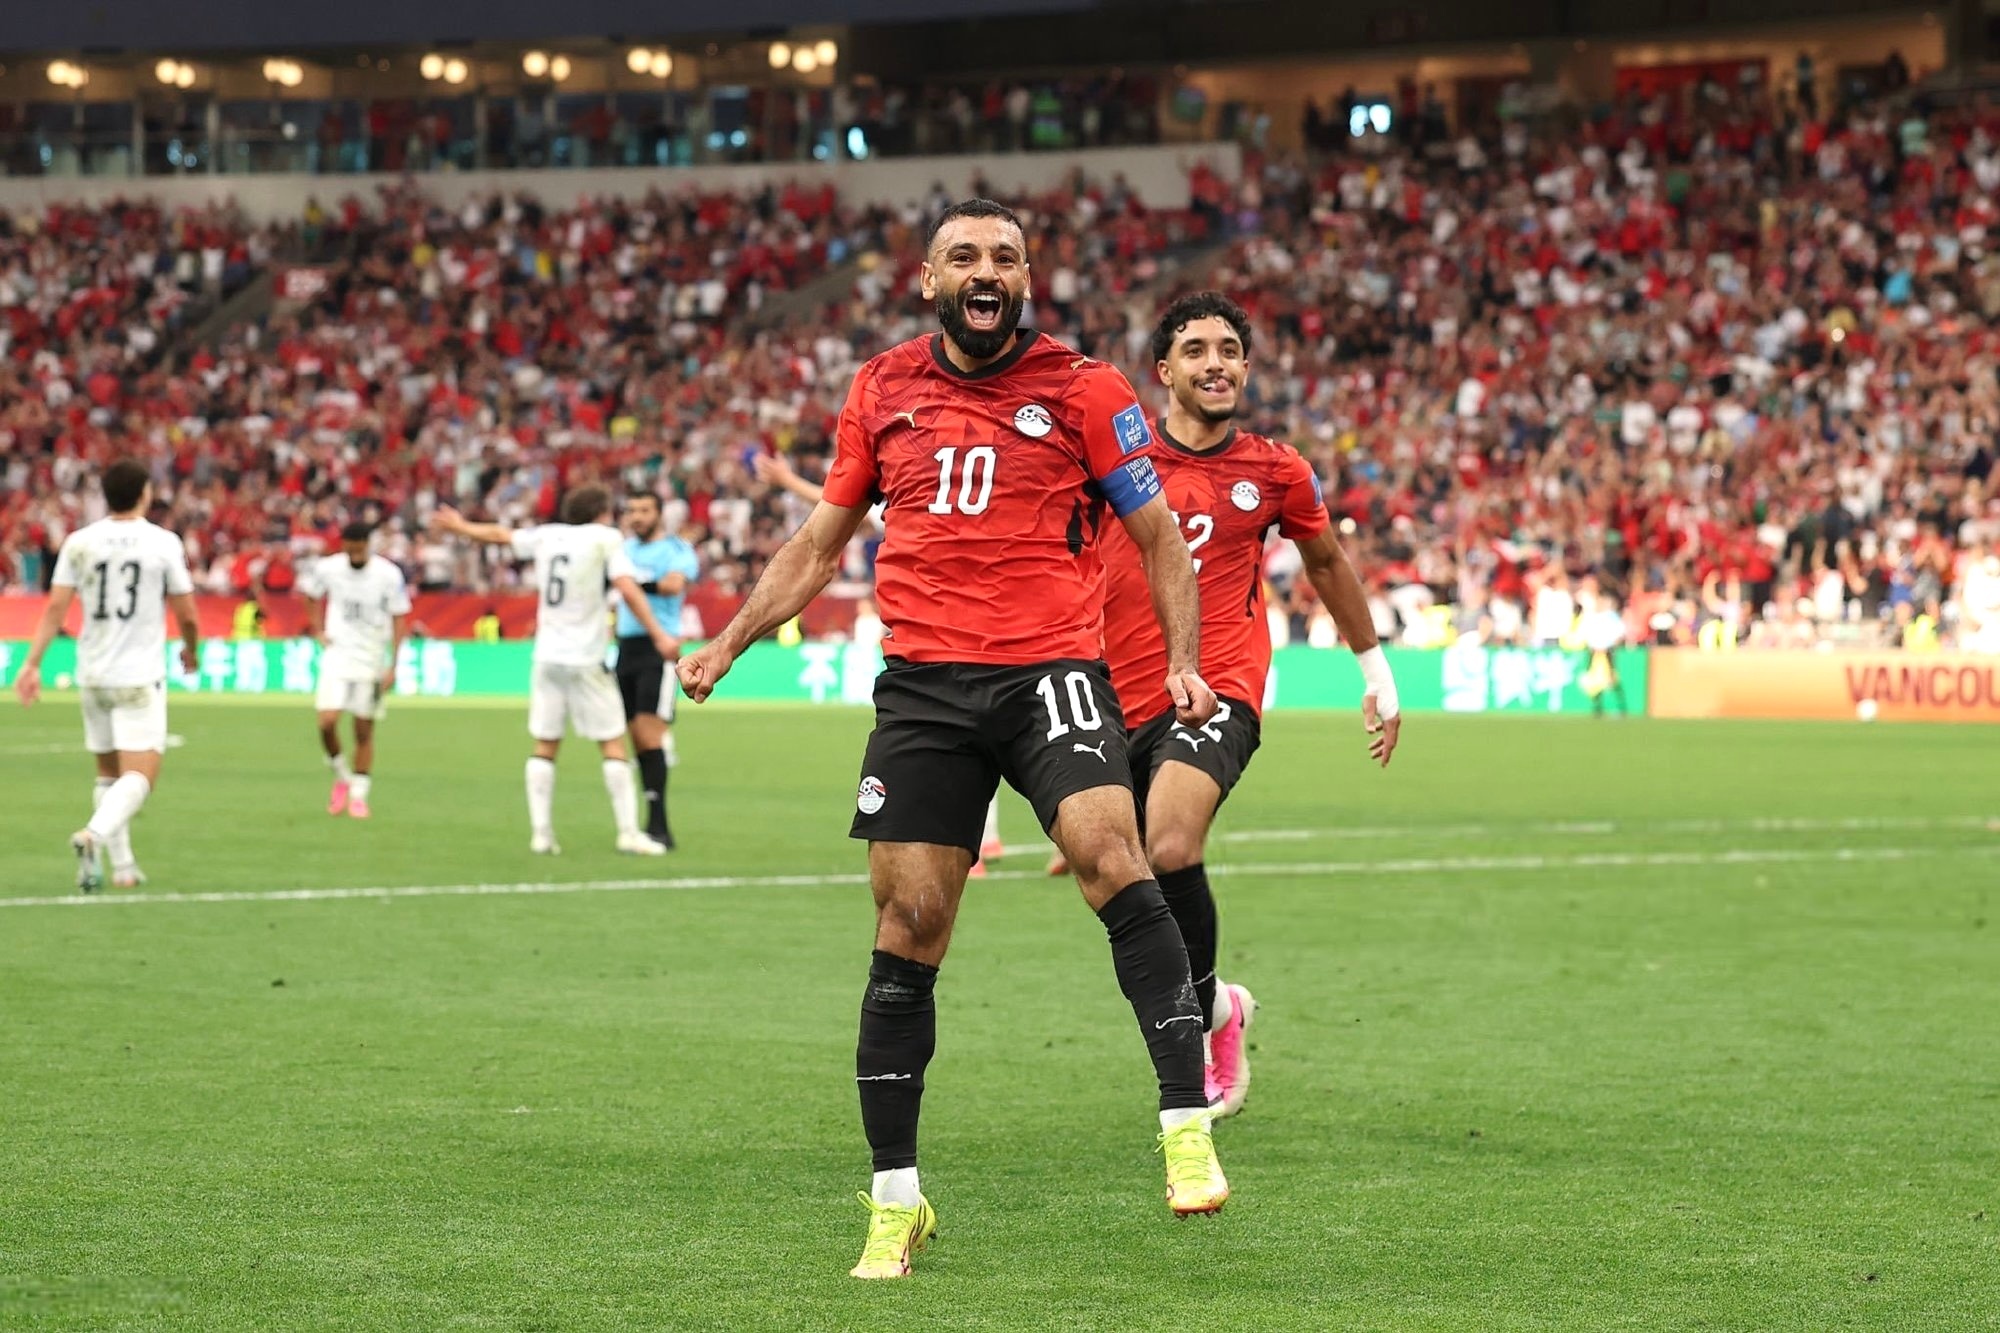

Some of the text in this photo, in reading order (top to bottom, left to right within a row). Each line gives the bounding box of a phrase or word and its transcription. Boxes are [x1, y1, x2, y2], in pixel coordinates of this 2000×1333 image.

[928, 446, 996, 515] 10
[1171, 511, 1214, 574] 2
[94, 560, 140, 621] 13
[545, 554, 568, 608] 6
[1036, 671, 1102, 742] 10
[1171, 701, 1231, 743] 2
